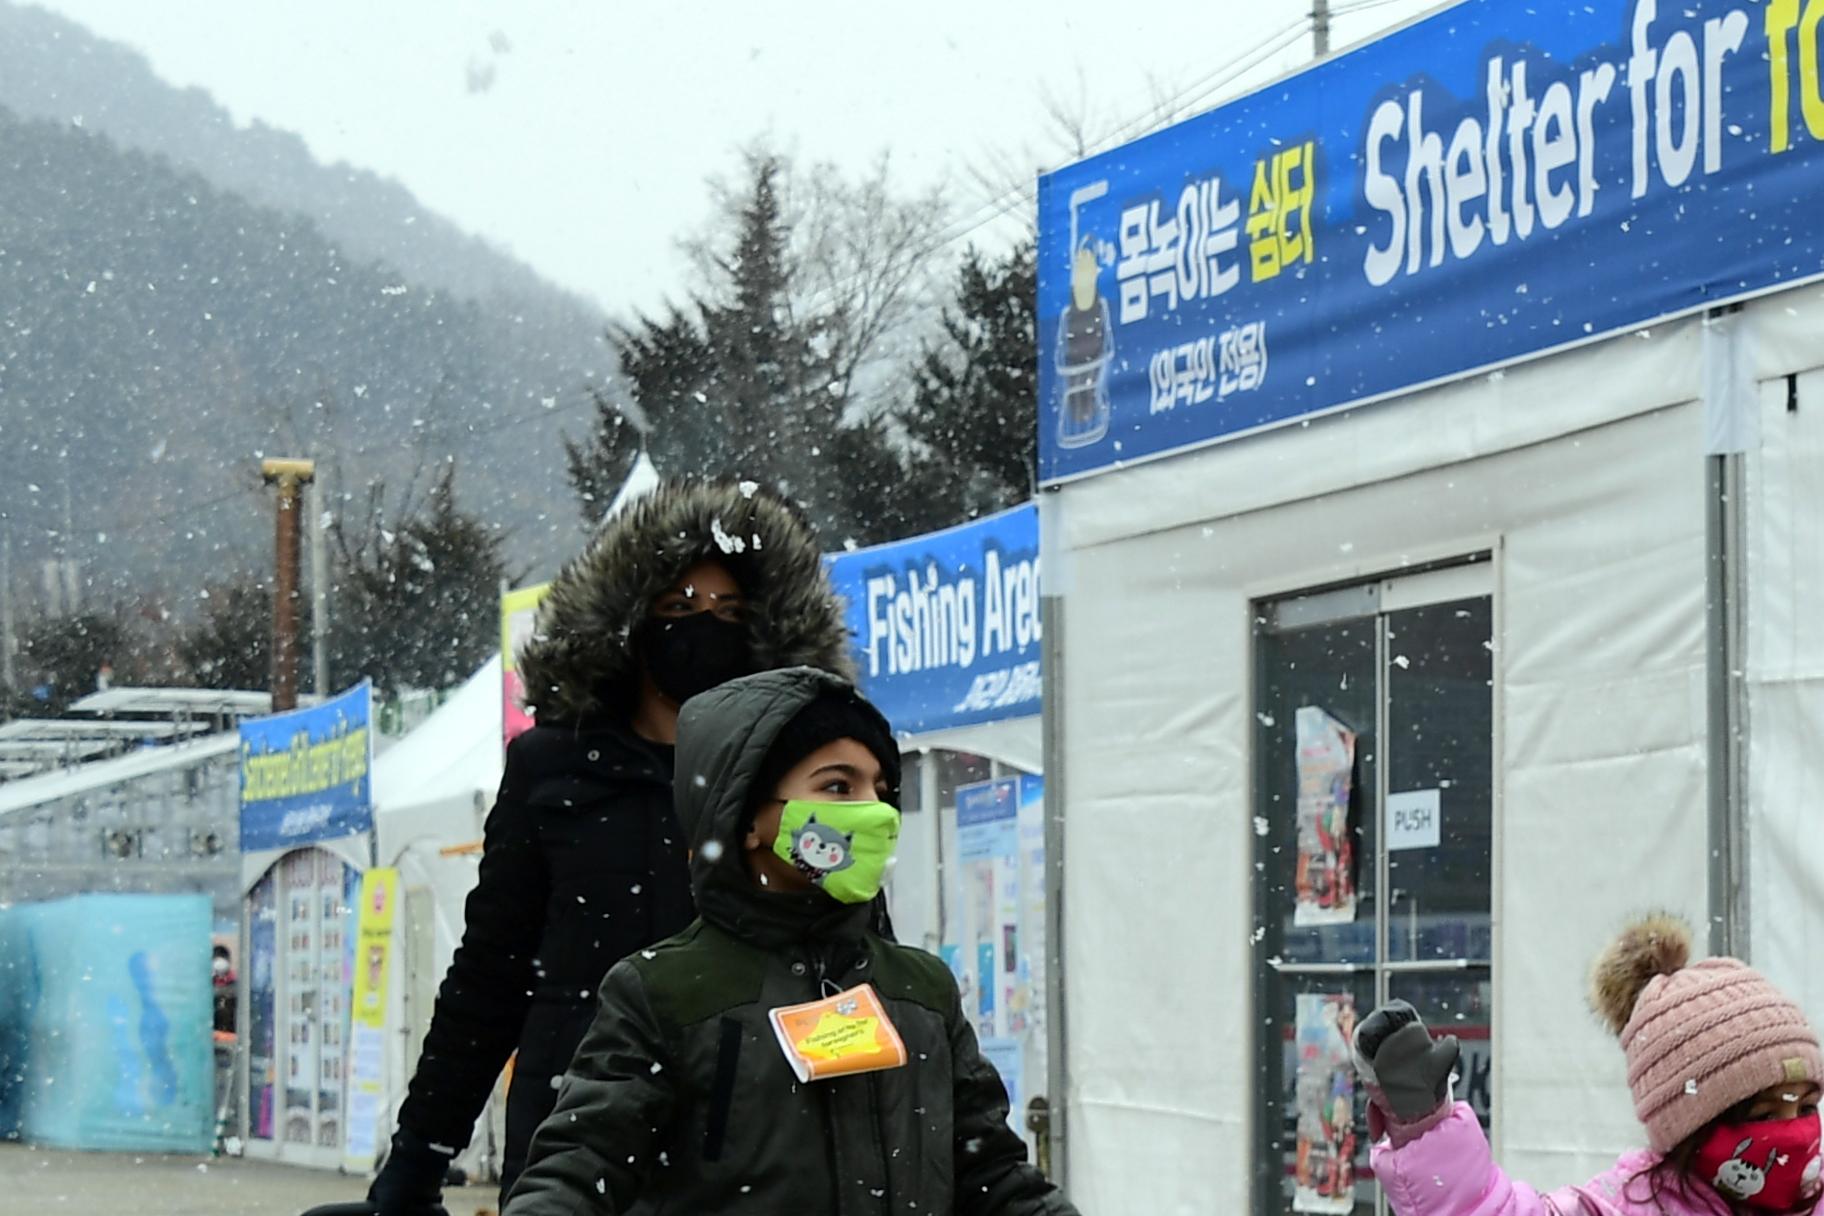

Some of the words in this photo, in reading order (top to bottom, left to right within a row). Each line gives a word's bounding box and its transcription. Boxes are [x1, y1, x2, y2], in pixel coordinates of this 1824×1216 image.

[1363, 56, 1614, 287] Shelter
[1626, 0, 1748, 200] for
[1245, 141, 1314, 283] 쉼터
[867, 563, 976, 678] Fishing
[1394, 808, 1431, 832] PUSH
